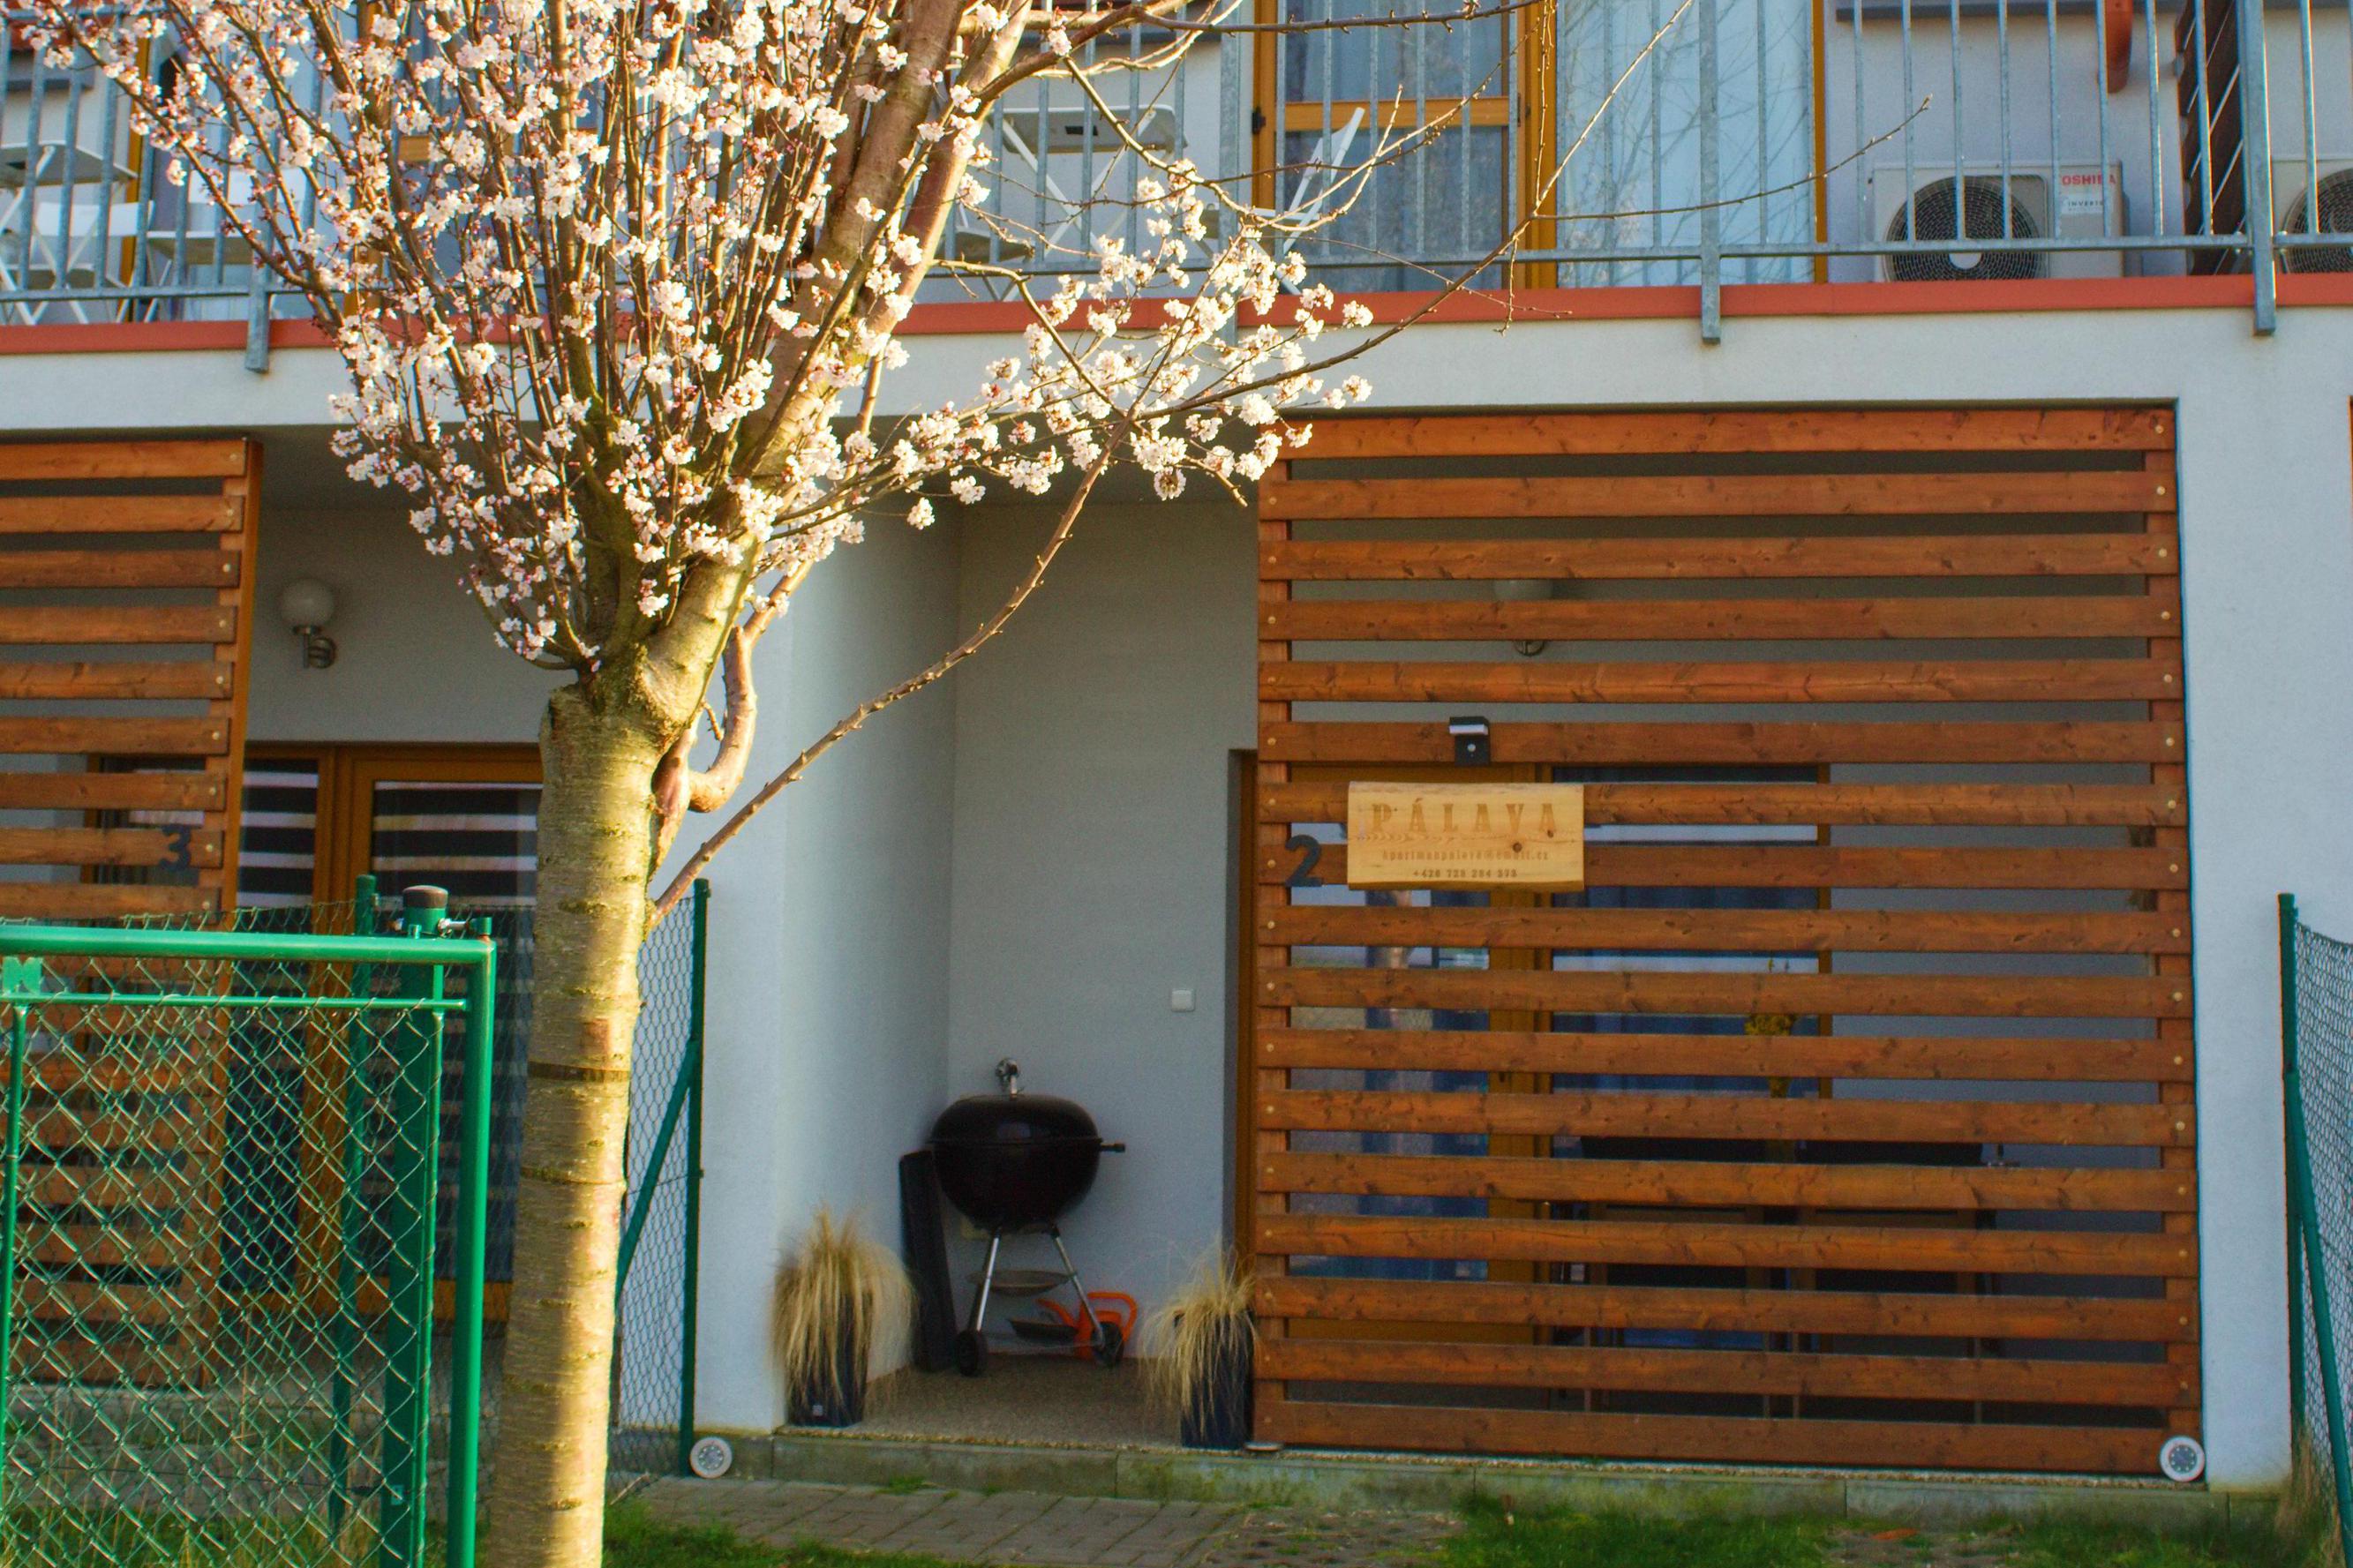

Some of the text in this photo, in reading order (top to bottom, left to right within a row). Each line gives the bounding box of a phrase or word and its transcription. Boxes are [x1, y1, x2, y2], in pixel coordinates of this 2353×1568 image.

[2062, 174, 2116, 186] OSHIA
[1372, 798, 1556, 833] PÁLAVA
[160, 824, 191, 871] 3
[1284, 835, 1321, 887] 2
